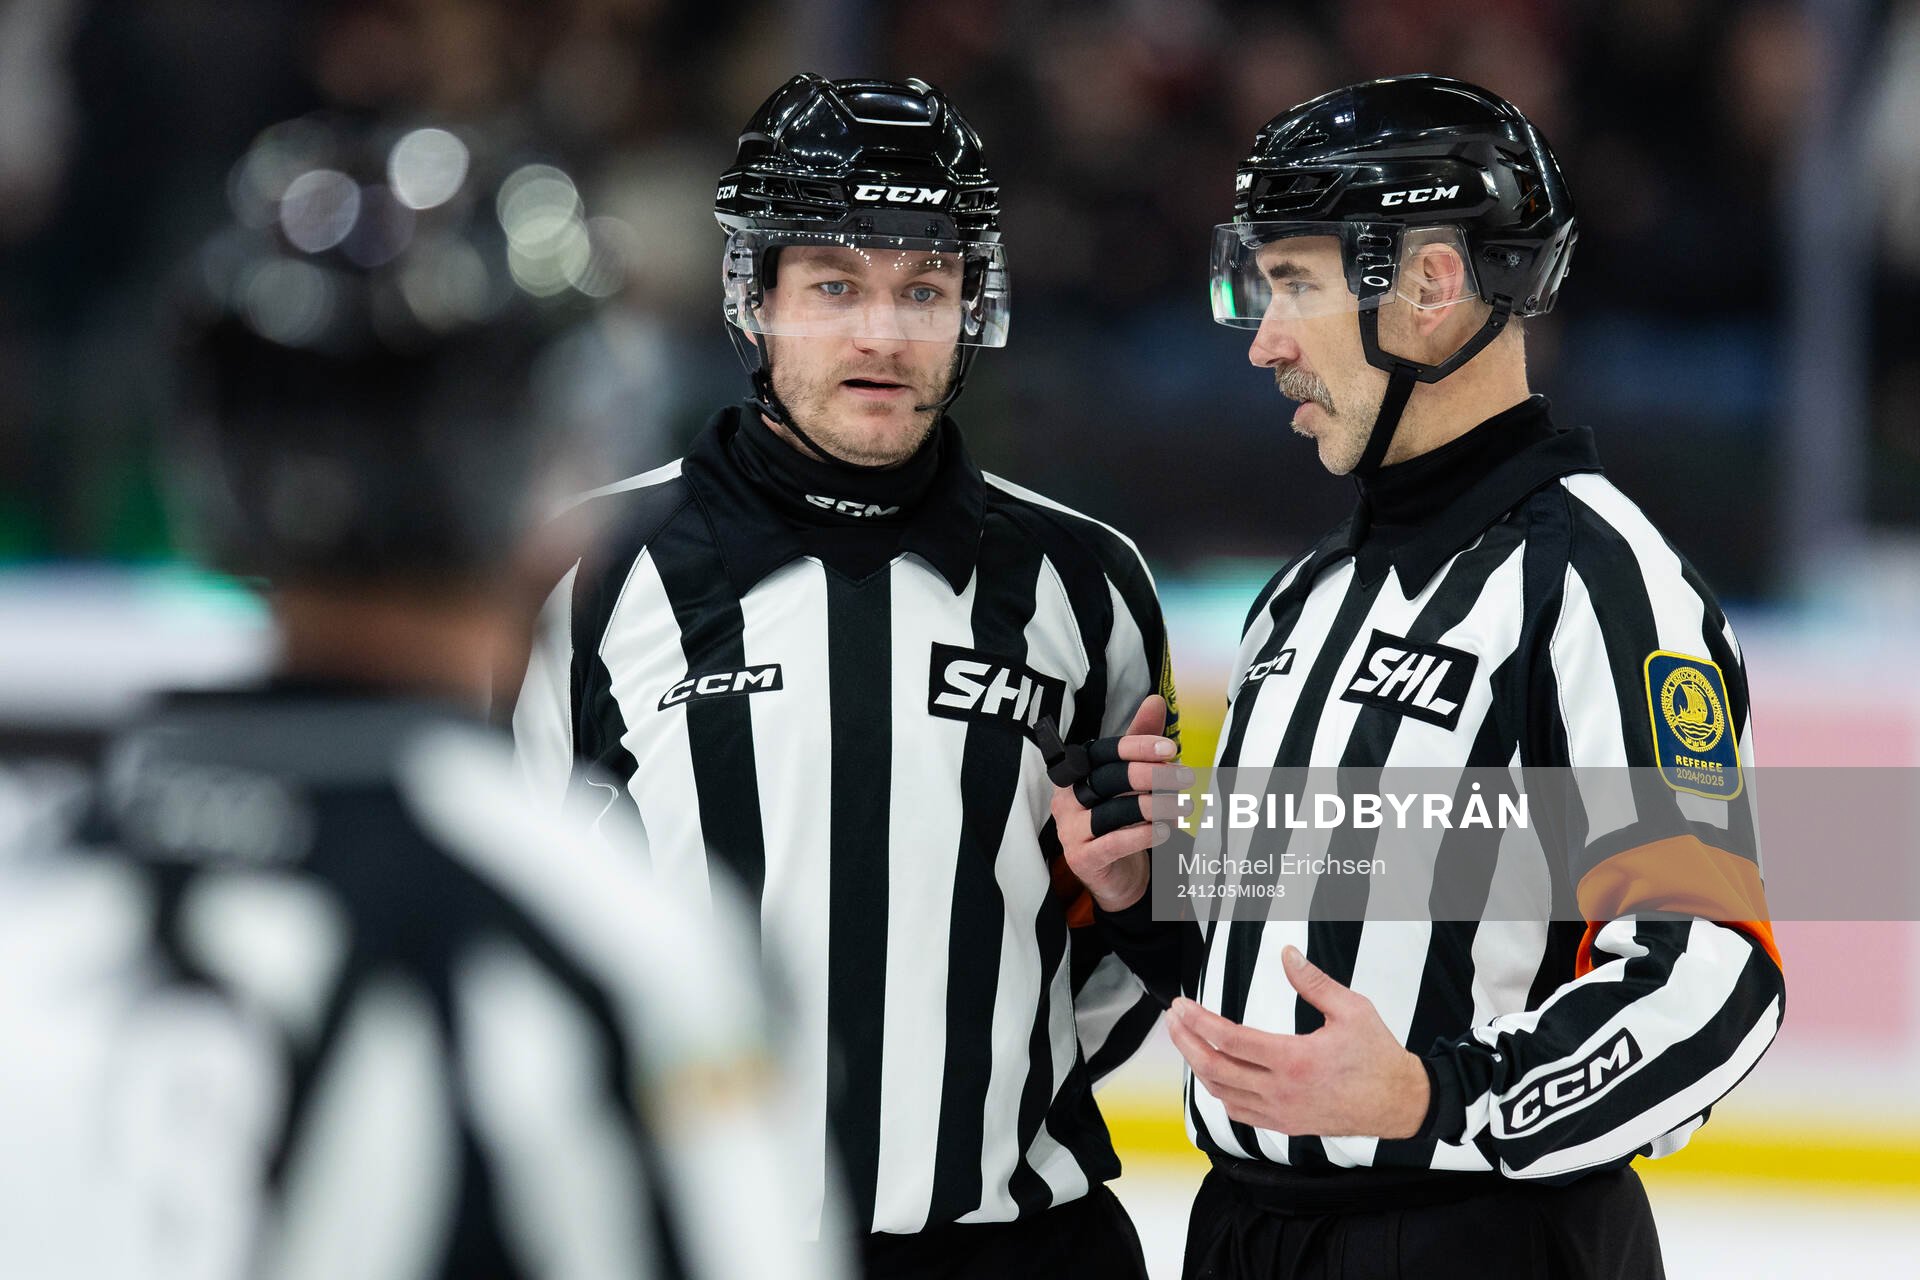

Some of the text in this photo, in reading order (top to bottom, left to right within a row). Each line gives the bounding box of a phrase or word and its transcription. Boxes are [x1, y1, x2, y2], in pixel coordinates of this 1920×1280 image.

[716, 184, 739, 200] CCM
[1236, 173, 1253, 192] CM
[854, 184, 948, 205] CCM
[1381, 185, 1460, 207] CCM
[662, 667, 777, 705] CCM
[1349, 647, 1459, 716] SHL
[1675, 754, 1724, 773] REFEREE
[1676, 767, 1725, 787] 2024/2025
[1511, 1035, 1630, 1129] CCM
